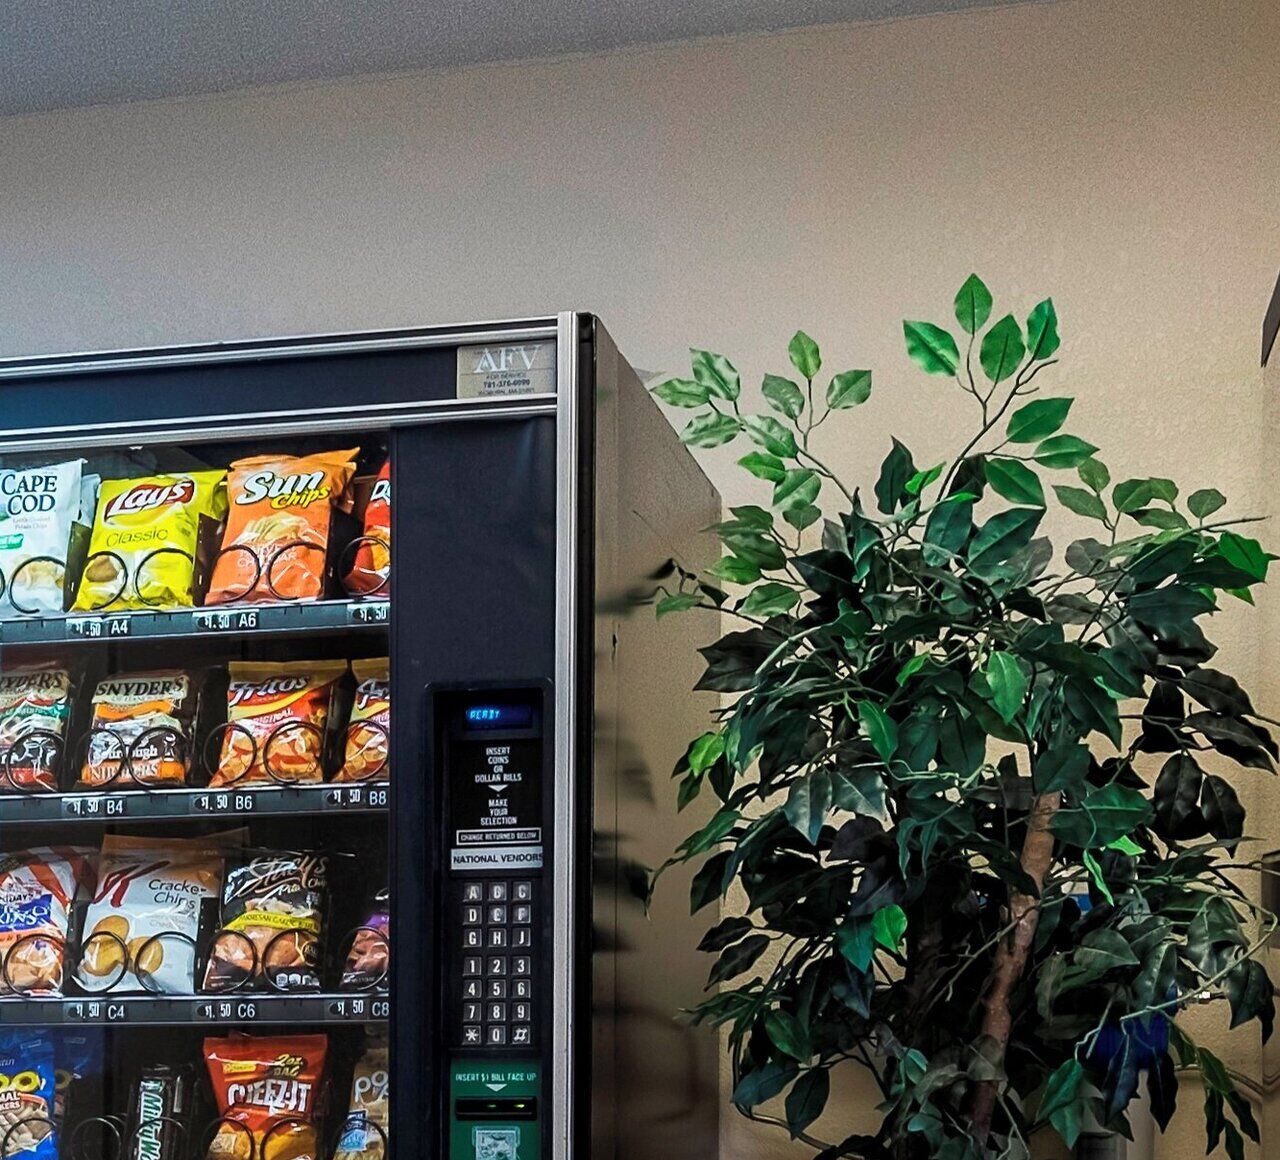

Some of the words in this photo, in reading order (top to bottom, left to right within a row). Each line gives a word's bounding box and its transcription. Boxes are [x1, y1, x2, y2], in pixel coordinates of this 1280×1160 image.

[473, 344, 542, 373] AFV
[2, 474, 57, 495] CAPE
[235, 469, 326, 505] Sun
[274, 486, 331, 509] Chips
[8, 494, 56, 515] COD
[107, 526, 169, 547] Classic
[238, 612, 256, 627] A6
[111, 619, 128, 634] A4
[229, 676, 310, 708] Fritos
[486, 747, 510, 755] INSERT
[488, 756, 509, 764] COINS
[494, 765, 503, 773] OR
[475, 774, 501, 783] DOLLAR
[235, 795, 252, 810] B6
[370, 790, 387, 805] B8
[488, 799, 508, 808] MAKE
[107, 799, 123, 814] B4
[490, 808, 508, 816] YOUR
[481, 816, 517, 825] SELECTION
[485, 832, 515, 840] RETURNED
[453, 854, 498, 864] NATIONAL
[501, 852, 543, 863] VENDORS
[470, 886, 477, 899] A
[519, 885, 526, 898] C
[470, 908, 477, 921] D
[494, 908, 501, 921] E
[519, 907, 525, 921] F
[469, 932, 476, 945] G
[493, 931, 501, 944] H
[519, 931, 524, 944] J
[470, 960, 475, 972] 1
[493, 960, 500, 973] 2
[518, 960, 525, 973] 3
[469, 983, 475, 996] 4
[493, 983, 500, 996] 5
[518, 983, 525, 996] 6
[108, 1004, 125, 1019] C4
[238, 1003, 255, 1018] C6
[372, 1002, 389, 1017] C8
[470, 1005, 475, 1018] 7
[493, 1005, 500, 1018] 8
[518, 1005, 525, 1018] 9
[493, 1028, 499, 1042] 0
[456, 1073, 479, 1081] INSERT
[491, 1073, 505, 1081] BILL
[507, 1073, 524, 1081] FACE
[527, 1073, 537, 1081] UP
